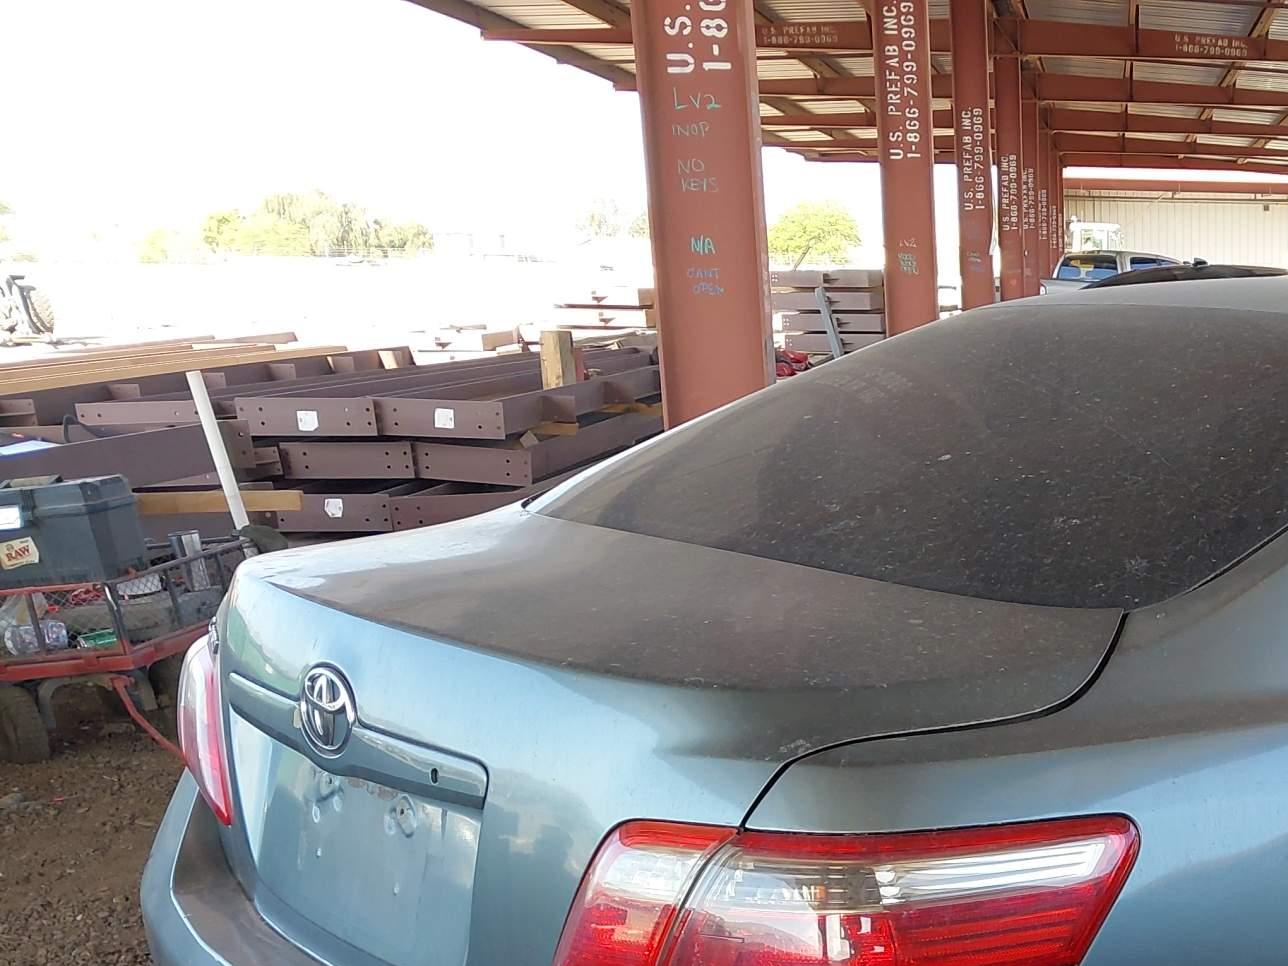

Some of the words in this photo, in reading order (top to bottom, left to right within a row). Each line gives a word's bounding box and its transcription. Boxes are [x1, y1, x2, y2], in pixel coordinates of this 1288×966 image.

[882, 0, 899, 35] INC.
[664, 4, 695, 74] U.S.
[885, 45, 902, 115] PREFAB
[900, 2, 921, 158] 1-866-799-0969
[961, 106, 972, 130] INC.
[889, 126, 904, 160] U.S.
[962, 135, 973, 182] PREFAB
[973, 108, 985, 209] 1-866-799-0969
[677, 158, 705, 174] NO
[964, 188, 974, 210] U.S.
[1001, 175, 1010, 210] PREFAB
[691, 234, 716, 255] N/A
[6, 544, 31, 562] RAW
